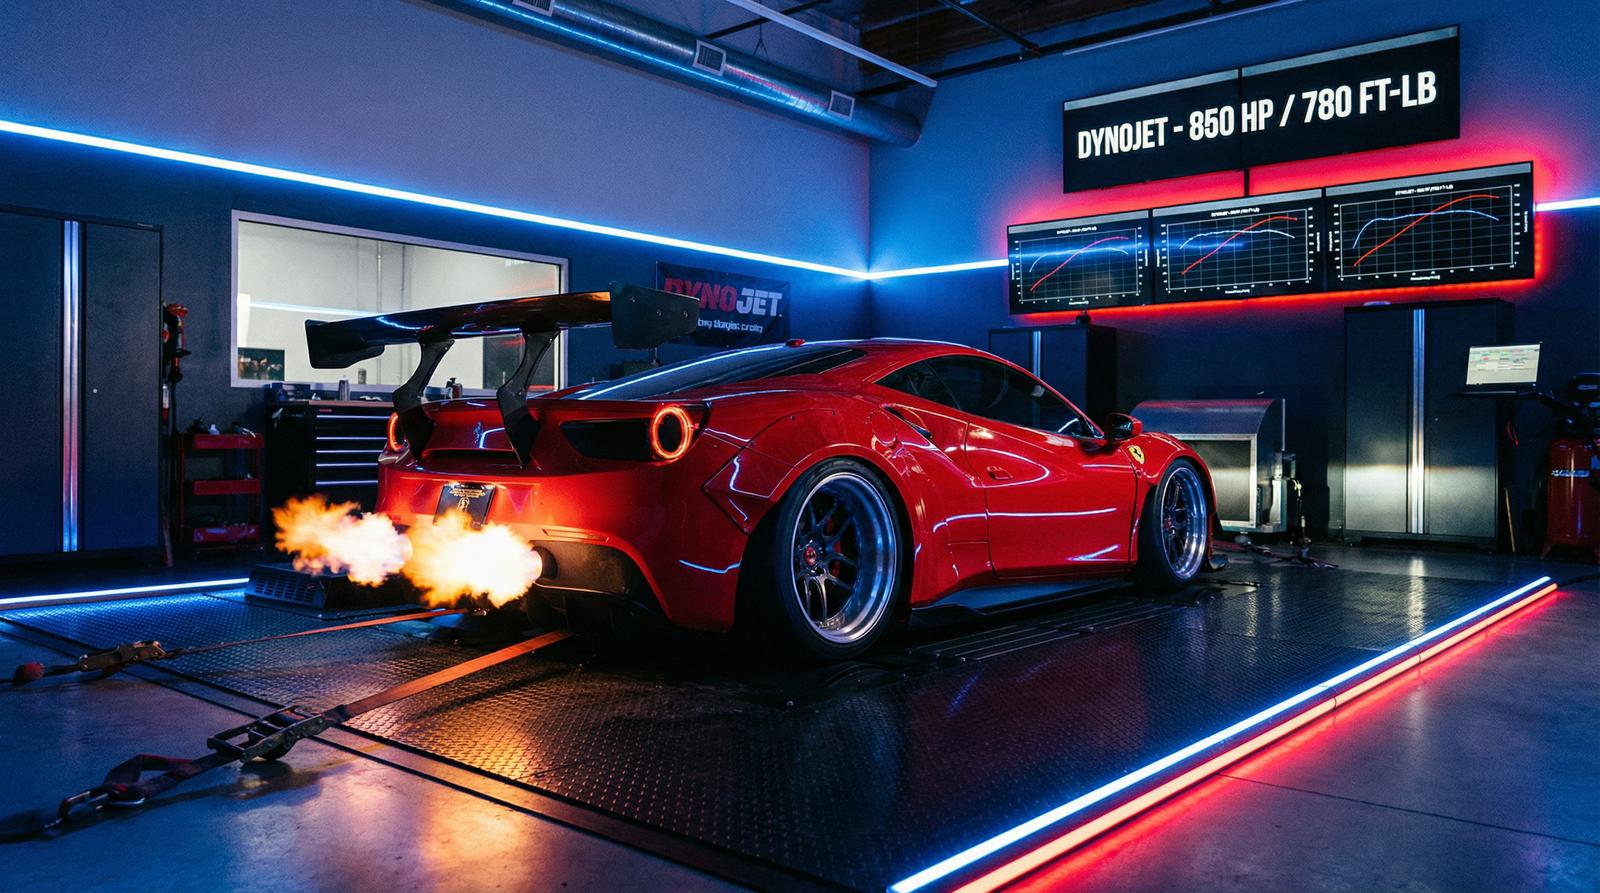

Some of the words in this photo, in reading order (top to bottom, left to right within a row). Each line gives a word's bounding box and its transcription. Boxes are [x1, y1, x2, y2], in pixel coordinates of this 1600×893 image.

[1078, 116, 1169, 159] DYNOJET
[1173, 125, 1184, 133] -
[1189, 105, 1235, 141] 850
[1241, 98, 1274, 133] HP
[1279, 93, 1297, 128] /
[1301, 85, 1352, 123] 780
[1359, 70, 1437, 115] FT-LB
